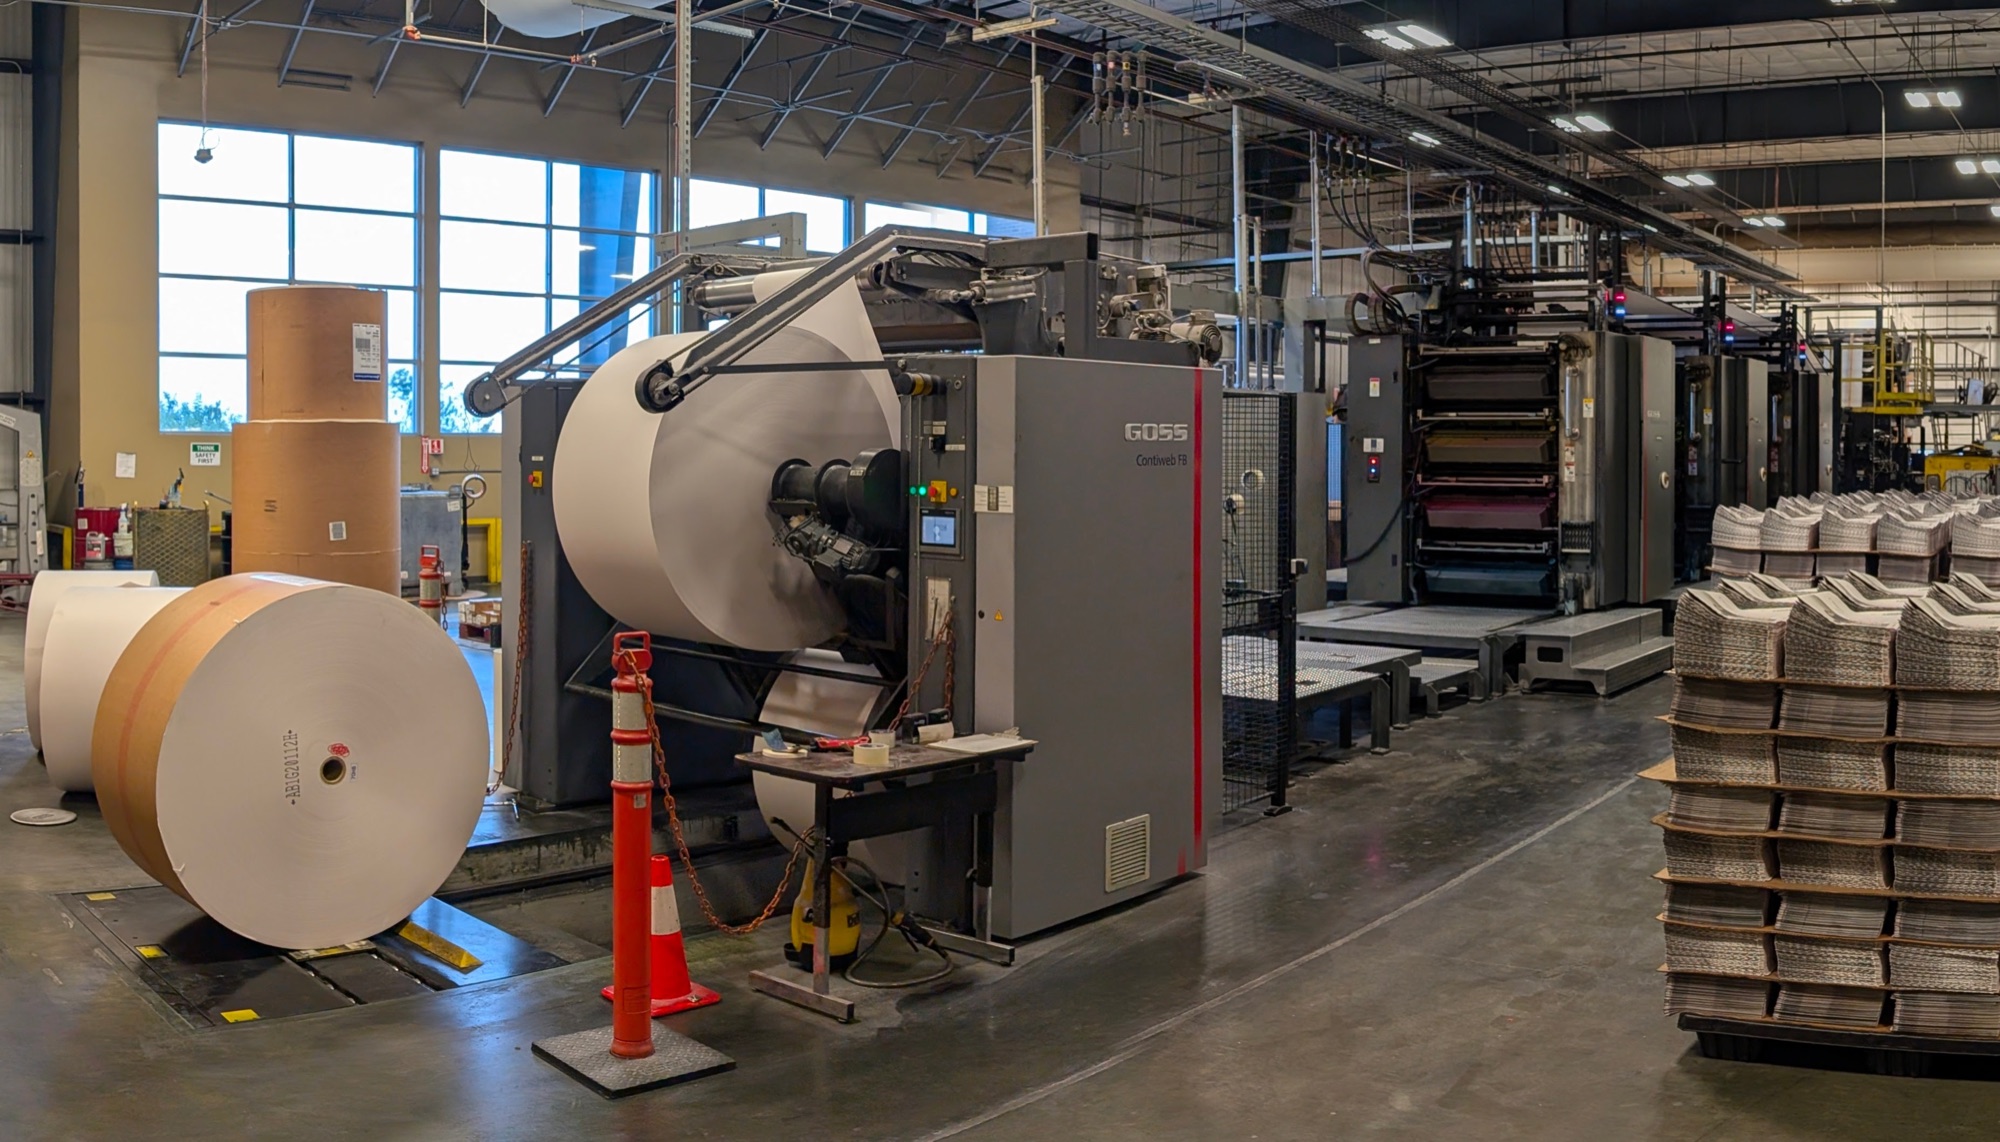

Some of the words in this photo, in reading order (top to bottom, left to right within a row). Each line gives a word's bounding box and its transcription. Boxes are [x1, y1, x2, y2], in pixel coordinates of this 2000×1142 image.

[1124, 423, 1188, 441] GOSS
[1136, 453, 1177, 467] Contiweb
[1178, 454, 1188, 466] FB
[283, 733, 301, 799] AB1G20112H
